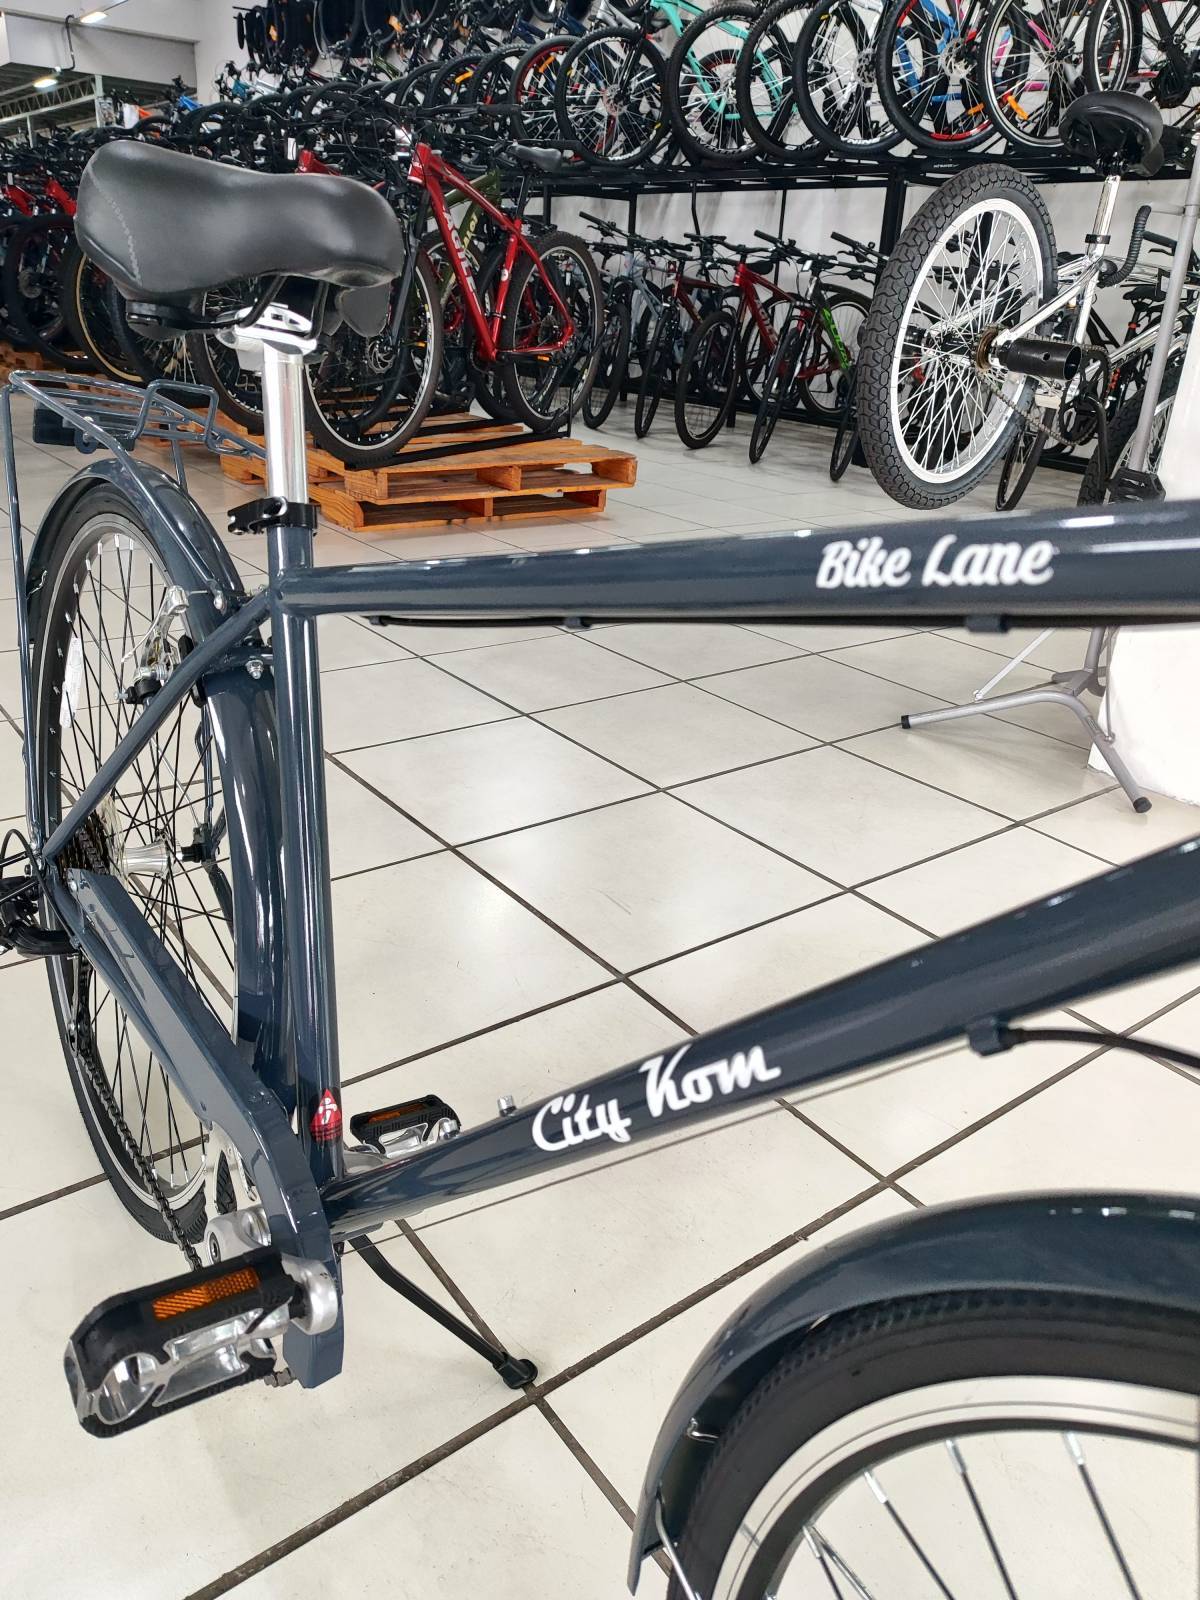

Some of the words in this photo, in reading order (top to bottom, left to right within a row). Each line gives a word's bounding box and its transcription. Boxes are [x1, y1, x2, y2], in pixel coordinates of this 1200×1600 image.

[443, 211, 477, 292] AGILE
[816, 536, 912, 588] Bike
[921, 533, 1056, 588] Lane
[531, 1093, 631, 1151] City
[639, 1043, 781, 1118] Kom
